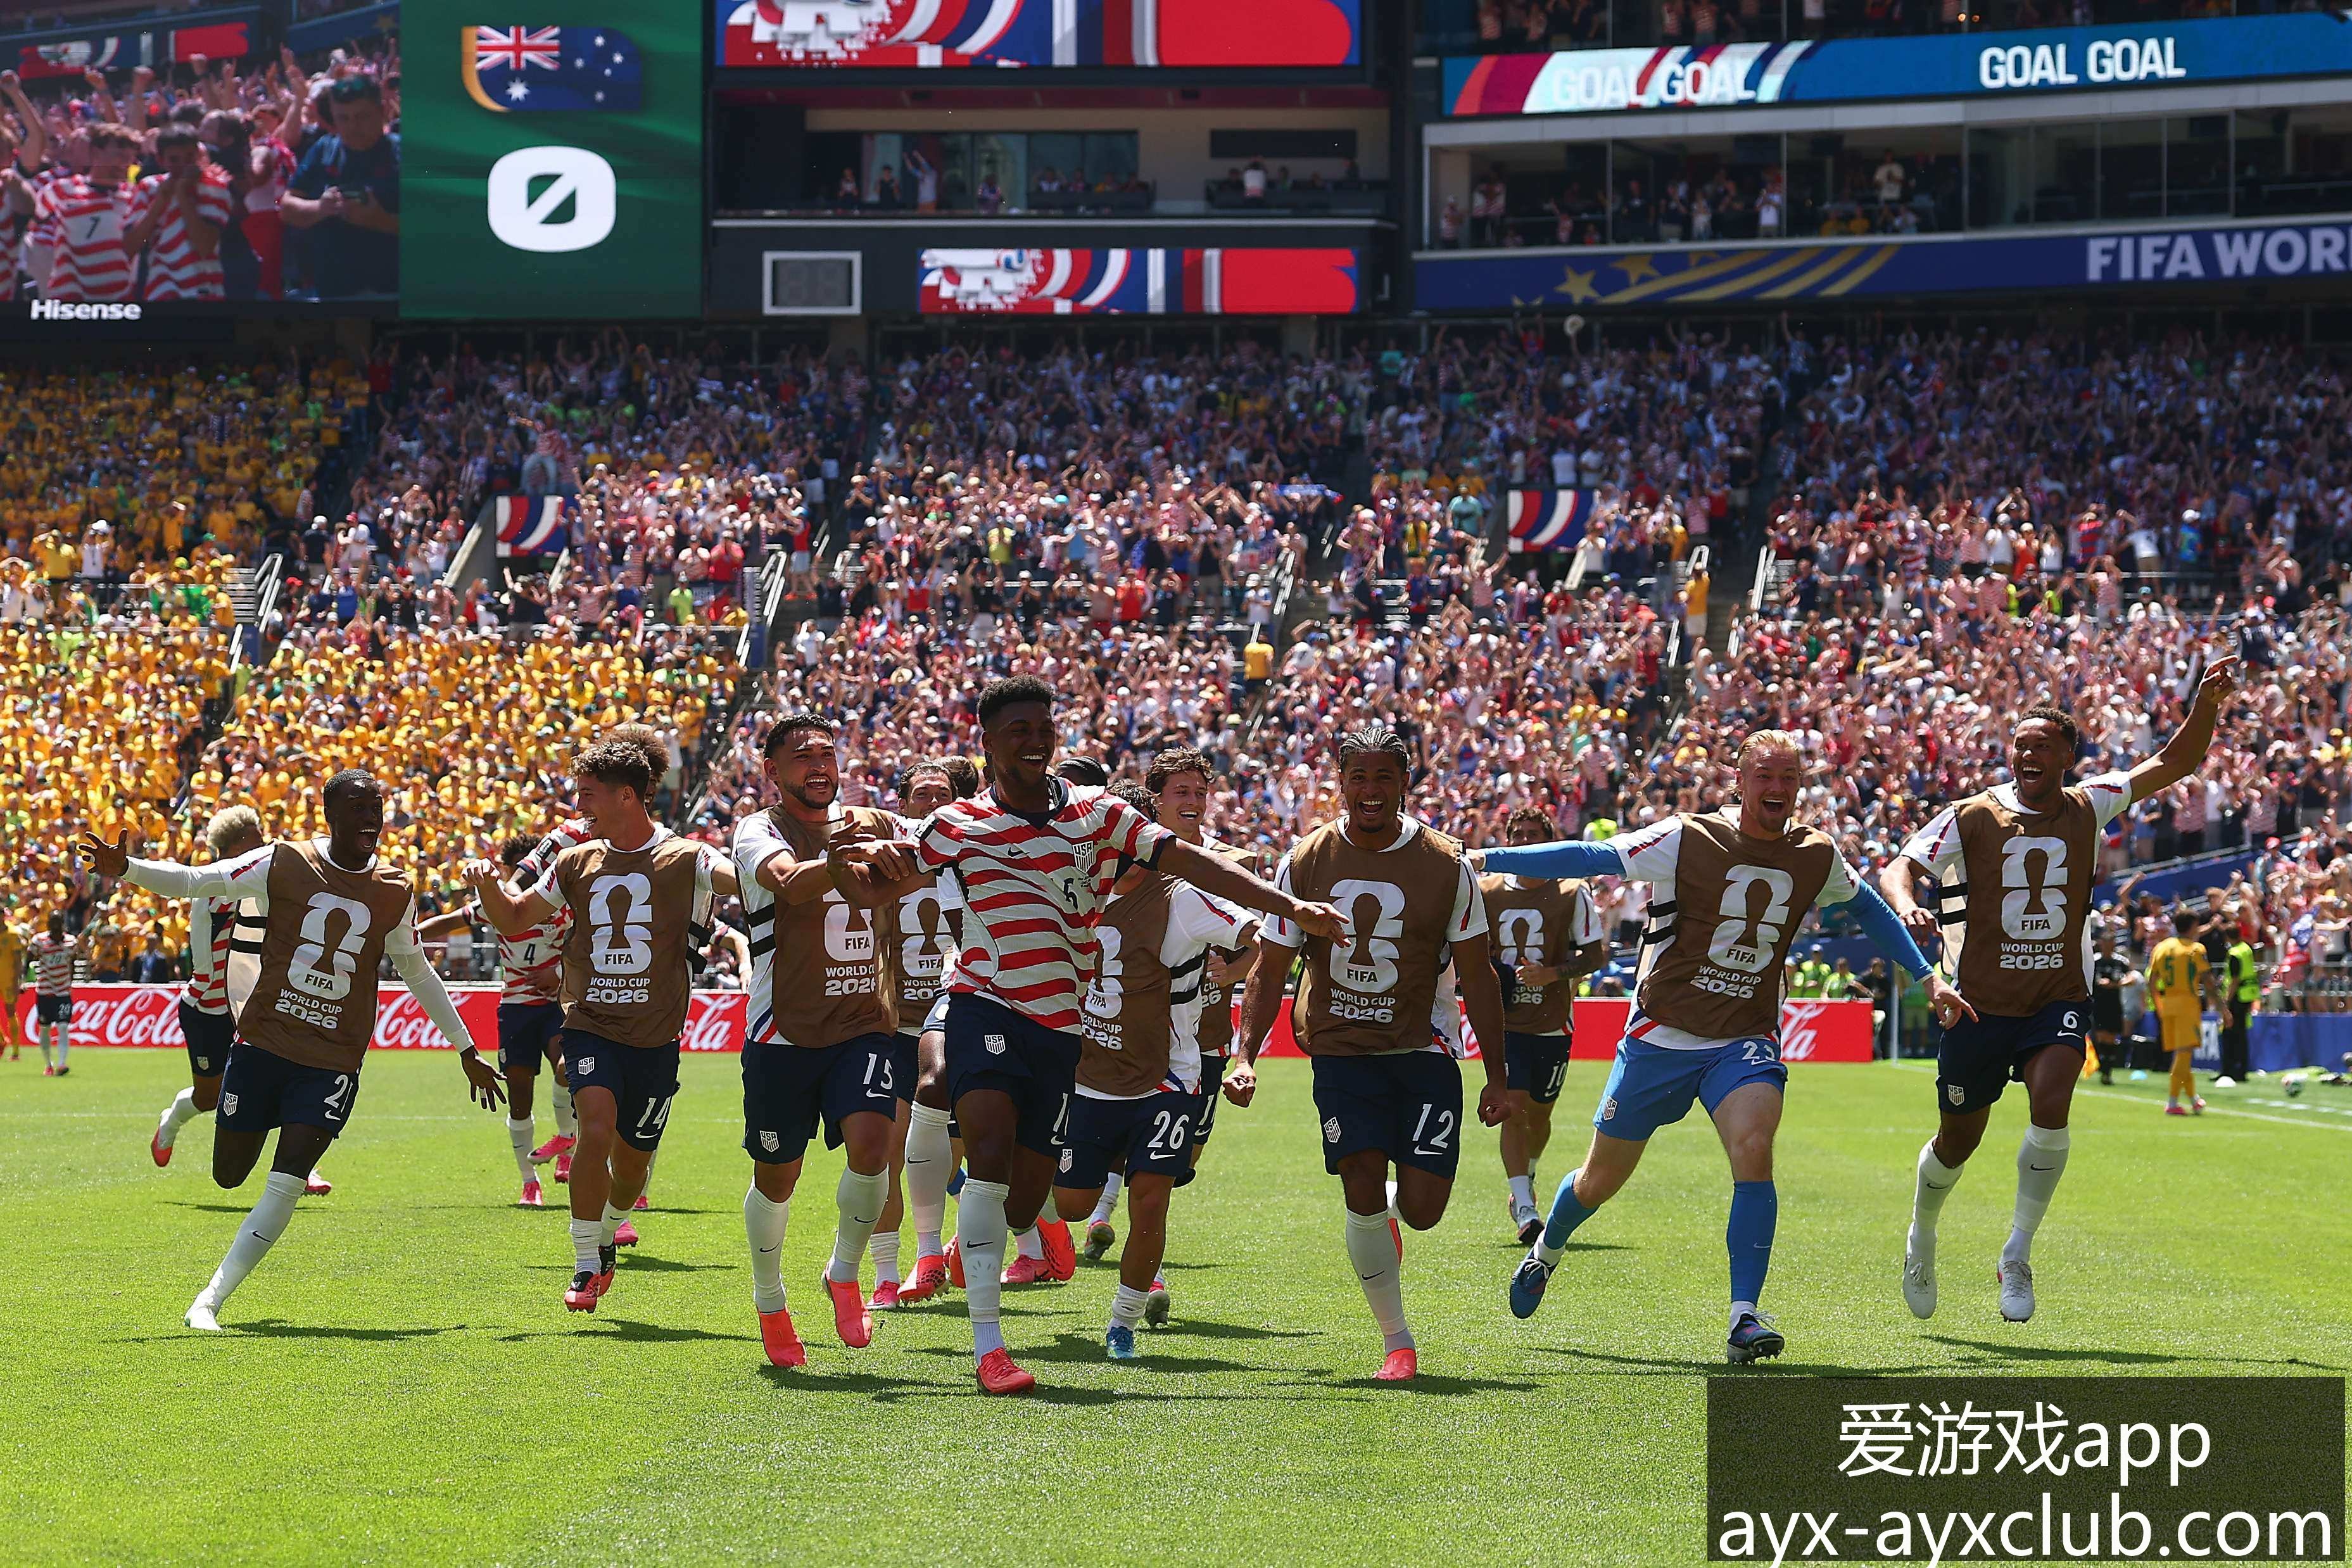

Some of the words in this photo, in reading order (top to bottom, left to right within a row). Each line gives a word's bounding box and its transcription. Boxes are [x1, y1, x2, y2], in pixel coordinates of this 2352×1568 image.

[1980, 43, 2078, 89] GOAL
[2087, 37, 2187, 82] GOAL
[1553, 66, 1647, 106] GOAL
[1661, 61, 1757, 103] GOAL
[488, 146, 616, 252] 0
[86, 216, 101, 239] 7
[2087, 234, 2205, 281] FIFA
[2213, 227, 2352, 276] WOR
[31, 299, 142, 320] Hisense
[1074, 842, 1092, 856] USA
[2021, 919, 2051, 930] FIFA
[845, 937, 870, 950] FIFA
[2001, 942, 2043, 953] WORLD
[2045, 942, 2064, 952] CUP
[524, 944, 536, 964] 4
[605, 954, 634, 964] FIFA
[1726, 949, 1755, 964] FIFA
[2000, 953, 2064, 970] 2026
[825, 965, 867, 977] WORLD
[1347, 968, 1378, 982] FIFA
[1698, 966, 1741, 982] WORLD
[2165, 956, 2174, 987] 5
[305, 974, 333, 991] FIFA
[590, 977, 626, 987] WORLD
[629, 978, 650, 987] CUP
[1690, 975, 1754, 999] 2026
[280, 989, 319, 1008] WORLD
[321, 1003, 343, 1014] CUP
[585, 988, 649, 1004] 2026
[1330, 988, 1369, 1006] WORLD
[1371, 997, 1396, 1006] CUP
[275, 999, 339, 1029] 2026
[1329, 1000, 1394, 1023] 2026
[2063, 1011, 2080, 1029] 6
[1103, 1021, 1123, 1034] CUP
[986, 1035, 1003, 1044] USA
[863, 1053, 893, 1090] 15
[226, 1095, 237, 1103] USA
[637, 1096, 672, 1130] 14
[1148, 1111, 1189, 1149] 26
[1325, 1118, 1337, 1131] USA
[1412, 1104, 1453, 1149] 12
[761, 1131, 776, 1139] USA
[1063, 1150, 1072, 1159] SA
